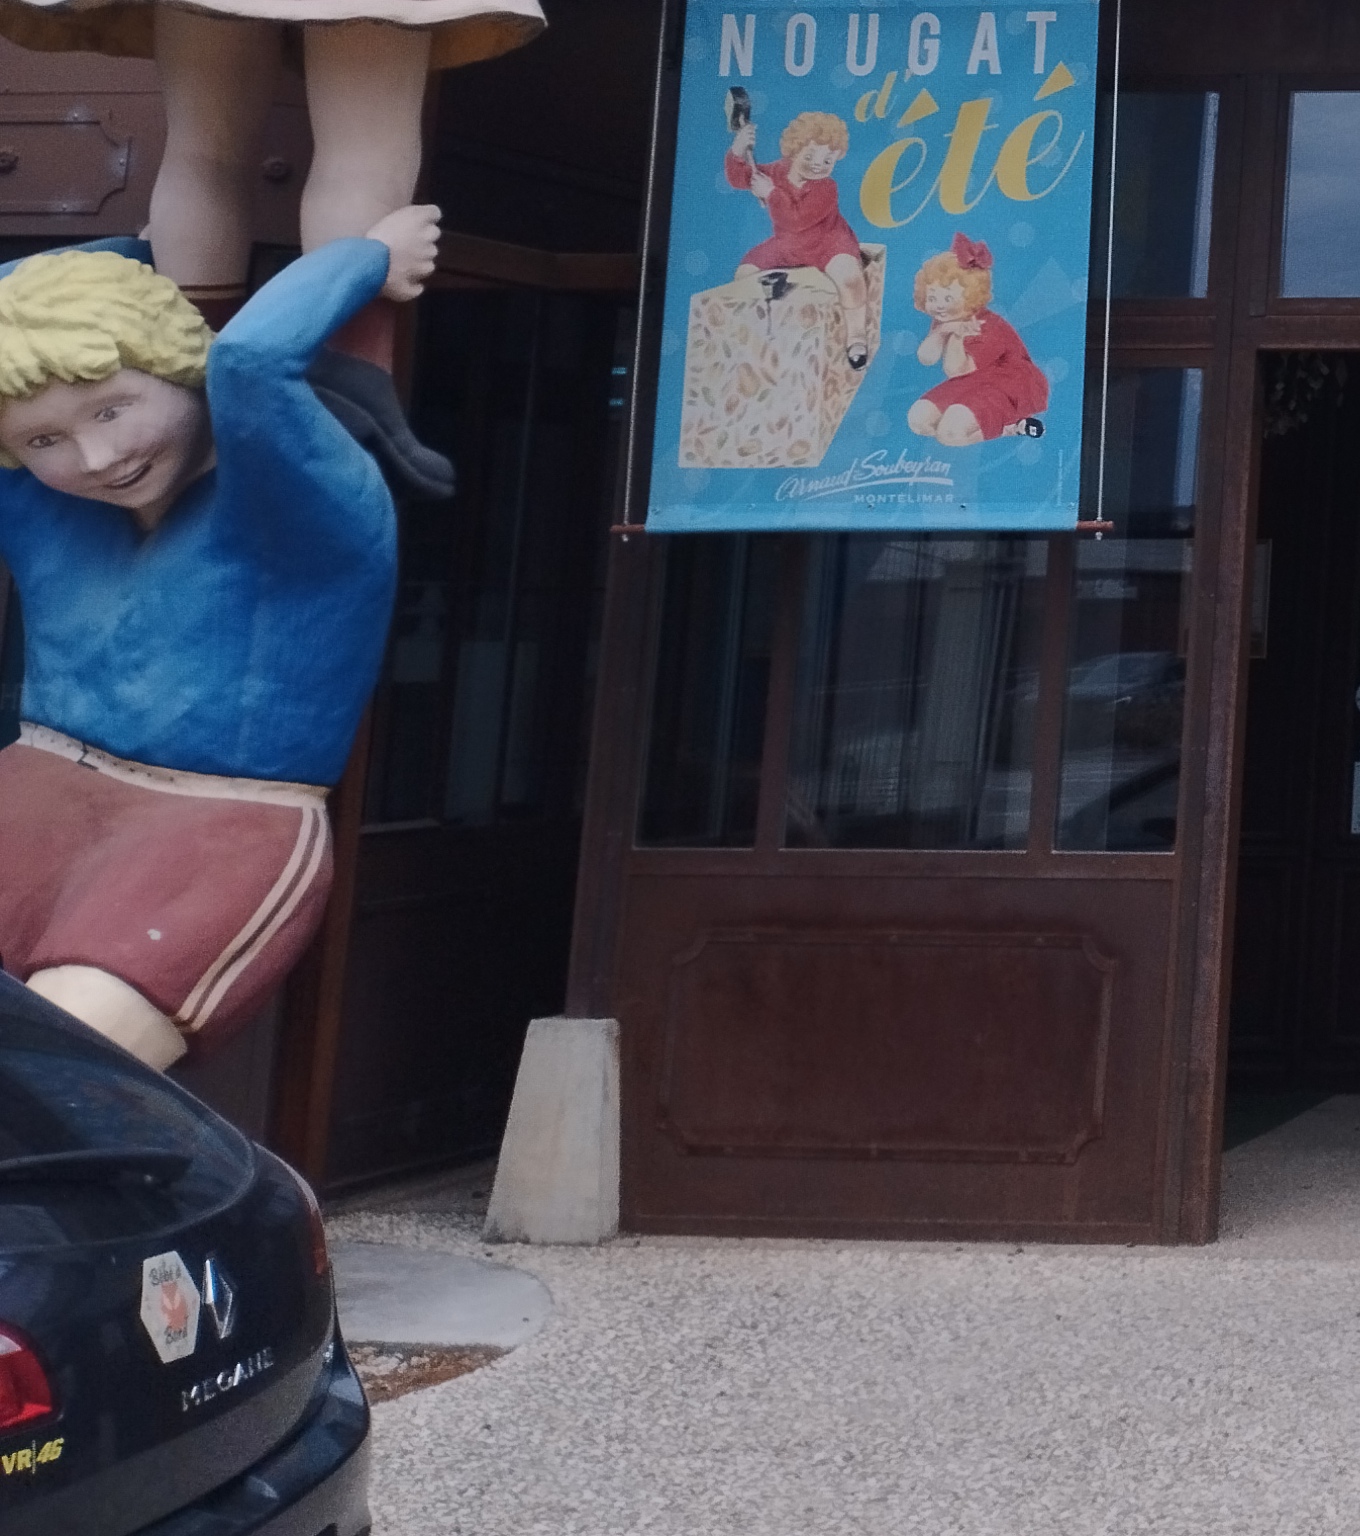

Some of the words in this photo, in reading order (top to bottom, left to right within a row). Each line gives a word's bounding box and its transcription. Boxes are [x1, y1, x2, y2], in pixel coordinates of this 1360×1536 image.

[718, 11, 1057, 77] NOUGAT
[854, 69, 914, 123] d'
[859, 60, 1086, 229] été
